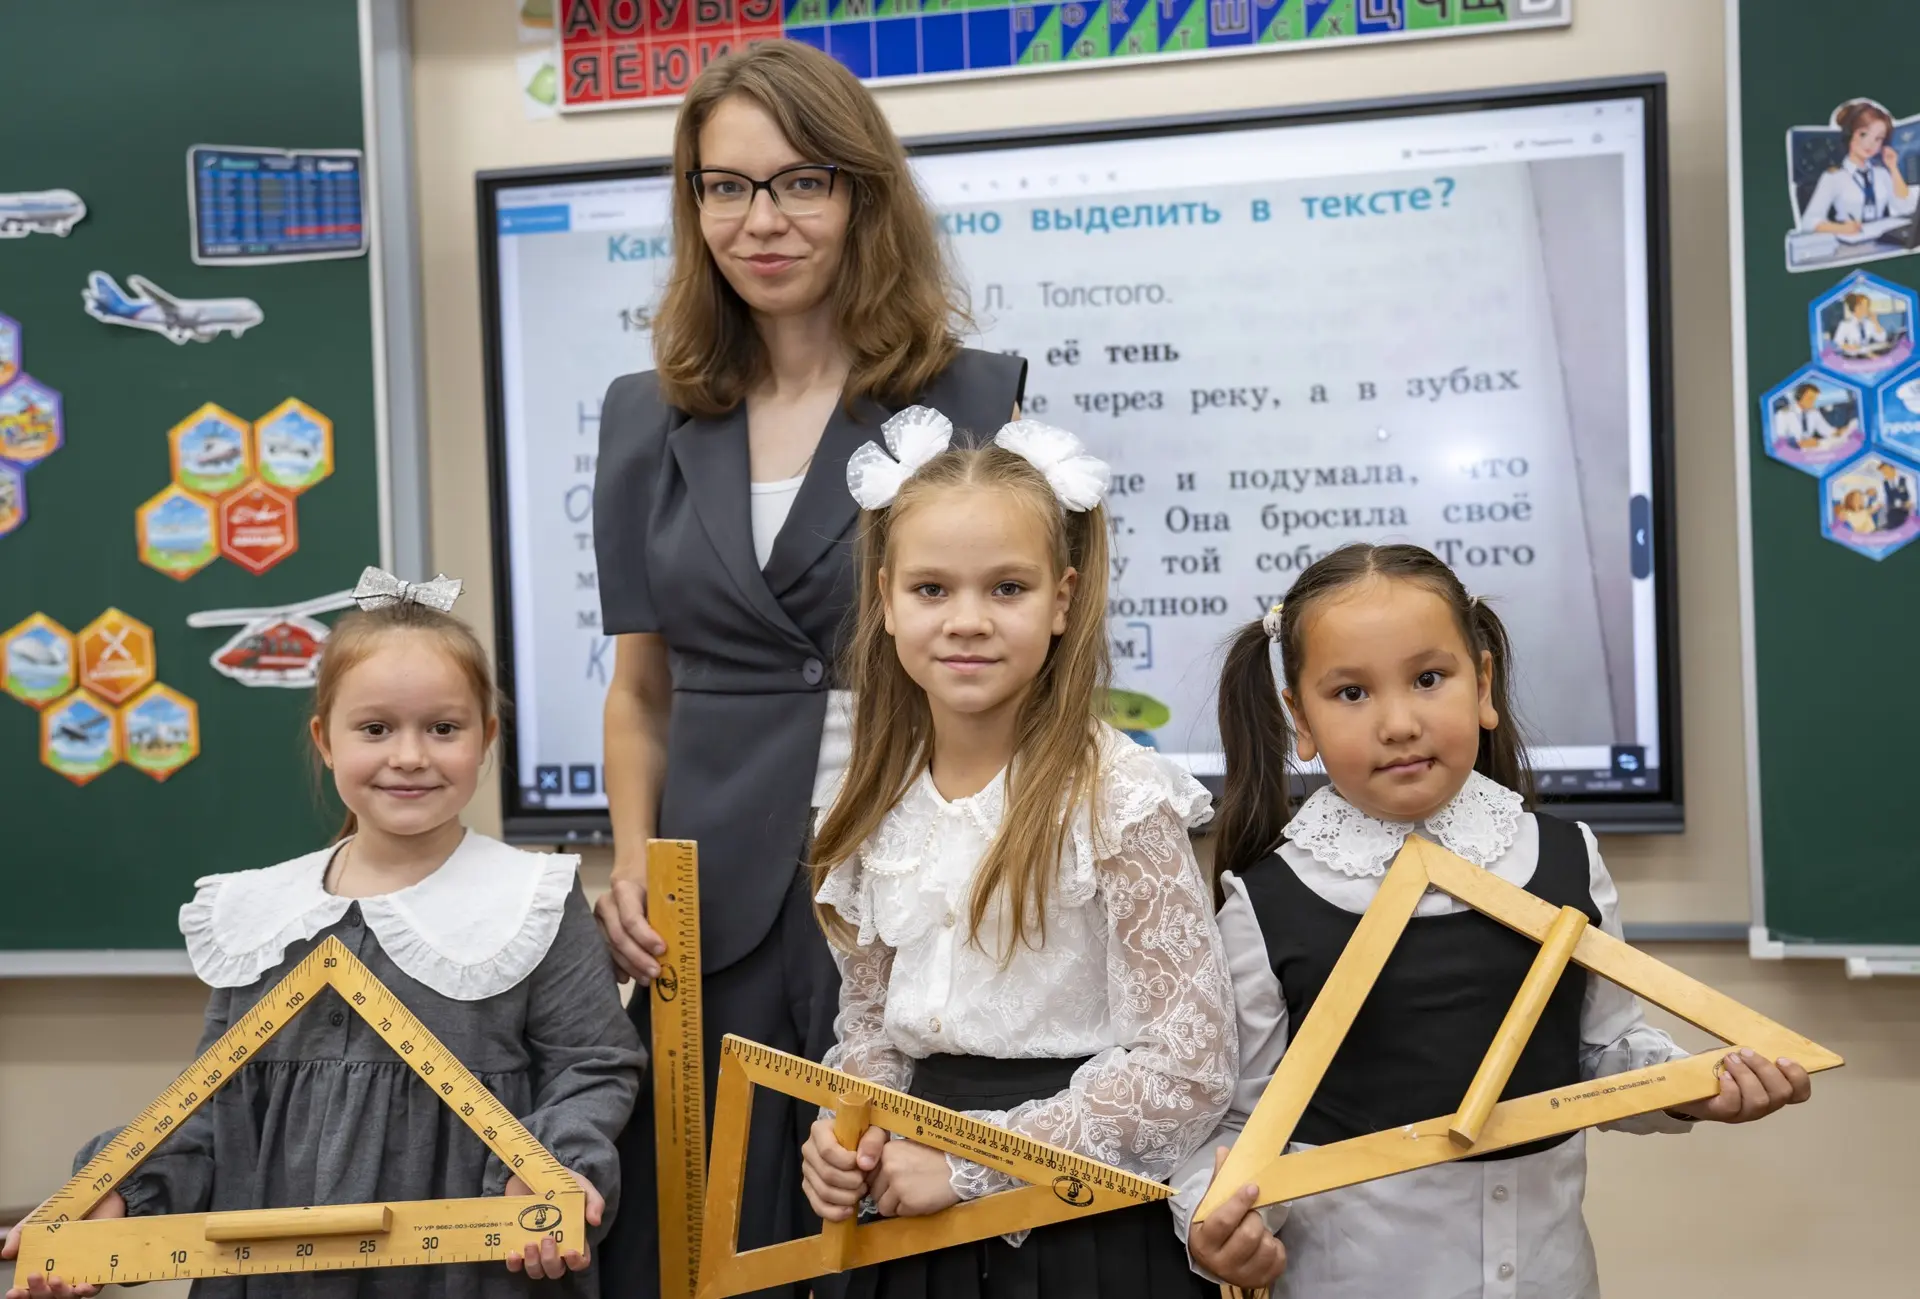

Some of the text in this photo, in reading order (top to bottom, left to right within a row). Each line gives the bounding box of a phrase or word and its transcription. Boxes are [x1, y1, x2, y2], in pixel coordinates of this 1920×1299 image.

[1214, 2, 1246, 32] Ш
[572, 56, 599, 94] Я
[653, 47, 691, 86] Ю
[607, 232, 667, 262] Как
[1031, 199, 1222, 235] выделить
[1251, 199, 1272, 222] в
[1301, 176, 1456, 220] тексте?
[984, 284, 1013, 311] Л.
[1037, 281, 1173, 310] Толстого.
[1046, 339, 1180, 366] её тень
[1074, 391, 1164, 417] через
[1191, 385, 1280, 414] реку,
[1310, 384, 1328, 403] а
[1357, 381, 1377, 401] в
[1407, 366, 1520, 403] зубах
[1176, 472, 1195, 491] и
[1229, 462, 1418, 493] подумала,
[1457, 457, 1529, 481] что
[1166, 506, 1230, 533] Она
[1261, 503, 1407, 535] бросила
[1443, 492, 1532, 524] своё
[1162, 547, 1221, 574] той
[1256, 544, 1318, 573] соб
[1436, 540, 1535, 566] Того
[680, 955, 686, 963] 10
[92, 1173, 112, 1192] 170
[126, 1141, 145, 1161] 160
[154, 1115, 174, 1135] 150
[178, 1092, 198, 1111] 140
[203, 1069, 222, 1089] 130
[228, 1045, 248, 1065] 120
[255, 1021, 274, 1040] 110
[286, 992, 304, 1010] 100
[324, 958, 337, 967] 90
[352, 992, 366, 1005] 80
[379, 1018, 392, 1032] 70
[400, 1040, 414, 1054] 60
[420, 1061, 435, 1075] 50
[440, 1082, 454, 1095] 40
[461, 1103, 474, 1117] 30
[483, 1126, 497, 1141] 20
[511, 1154, 524, 1168] 10
[545, 1190, 555, 1201] 0
[725, 1047, 730, 1055] 0
[828, 1083, 836, 1092] 10
[881, 1103, 888, 1111] 15
[903, 1110, 910, 1118] 17
[913, 1114, 920, 1122] 18
[924, 1117, 932, 1125] 19
[933, 1120, 943, 1129] 20
[945, 1125, 952, 1133] 21
[956, 1129, 964, 1137] 22
[967, 1132, 975, 1140] 23
[978, 1137, 986, 1145] 24
[989, 1141, 998, 1149] 25
[1001, 1145, 1009, 1153] 26
[1023, 1153, 1032, 1161] 28
[1035, 1156, 1043, 1165] 29
[1046, 1159, 1056, 1169] 30
[1058, 1165, 1067, 1173] 31
[1069, 1169, 1078, 1177] 32
[1081, 1173, 1091, 1181] 33
[1093, 1177, 1102, 1185] 34
[1105, 1181, 1114, 1189] 35
[1117, 1185, 1126, 1194] 36
[1129, 1189, 1138, 1198] 37
[46, 1259, 54, 1272] 0
[110, 1254, 118, 1268] 5
[171, 1250, 187, 1264] 10
[234, 1247, 250, 1260] 15
[297, 1243, 313, 1257] 20
[360, 1240, 376, 1253] 25
[422, 1237, 438, 1250] 30
[484, 1234, 501, 1246] 35
